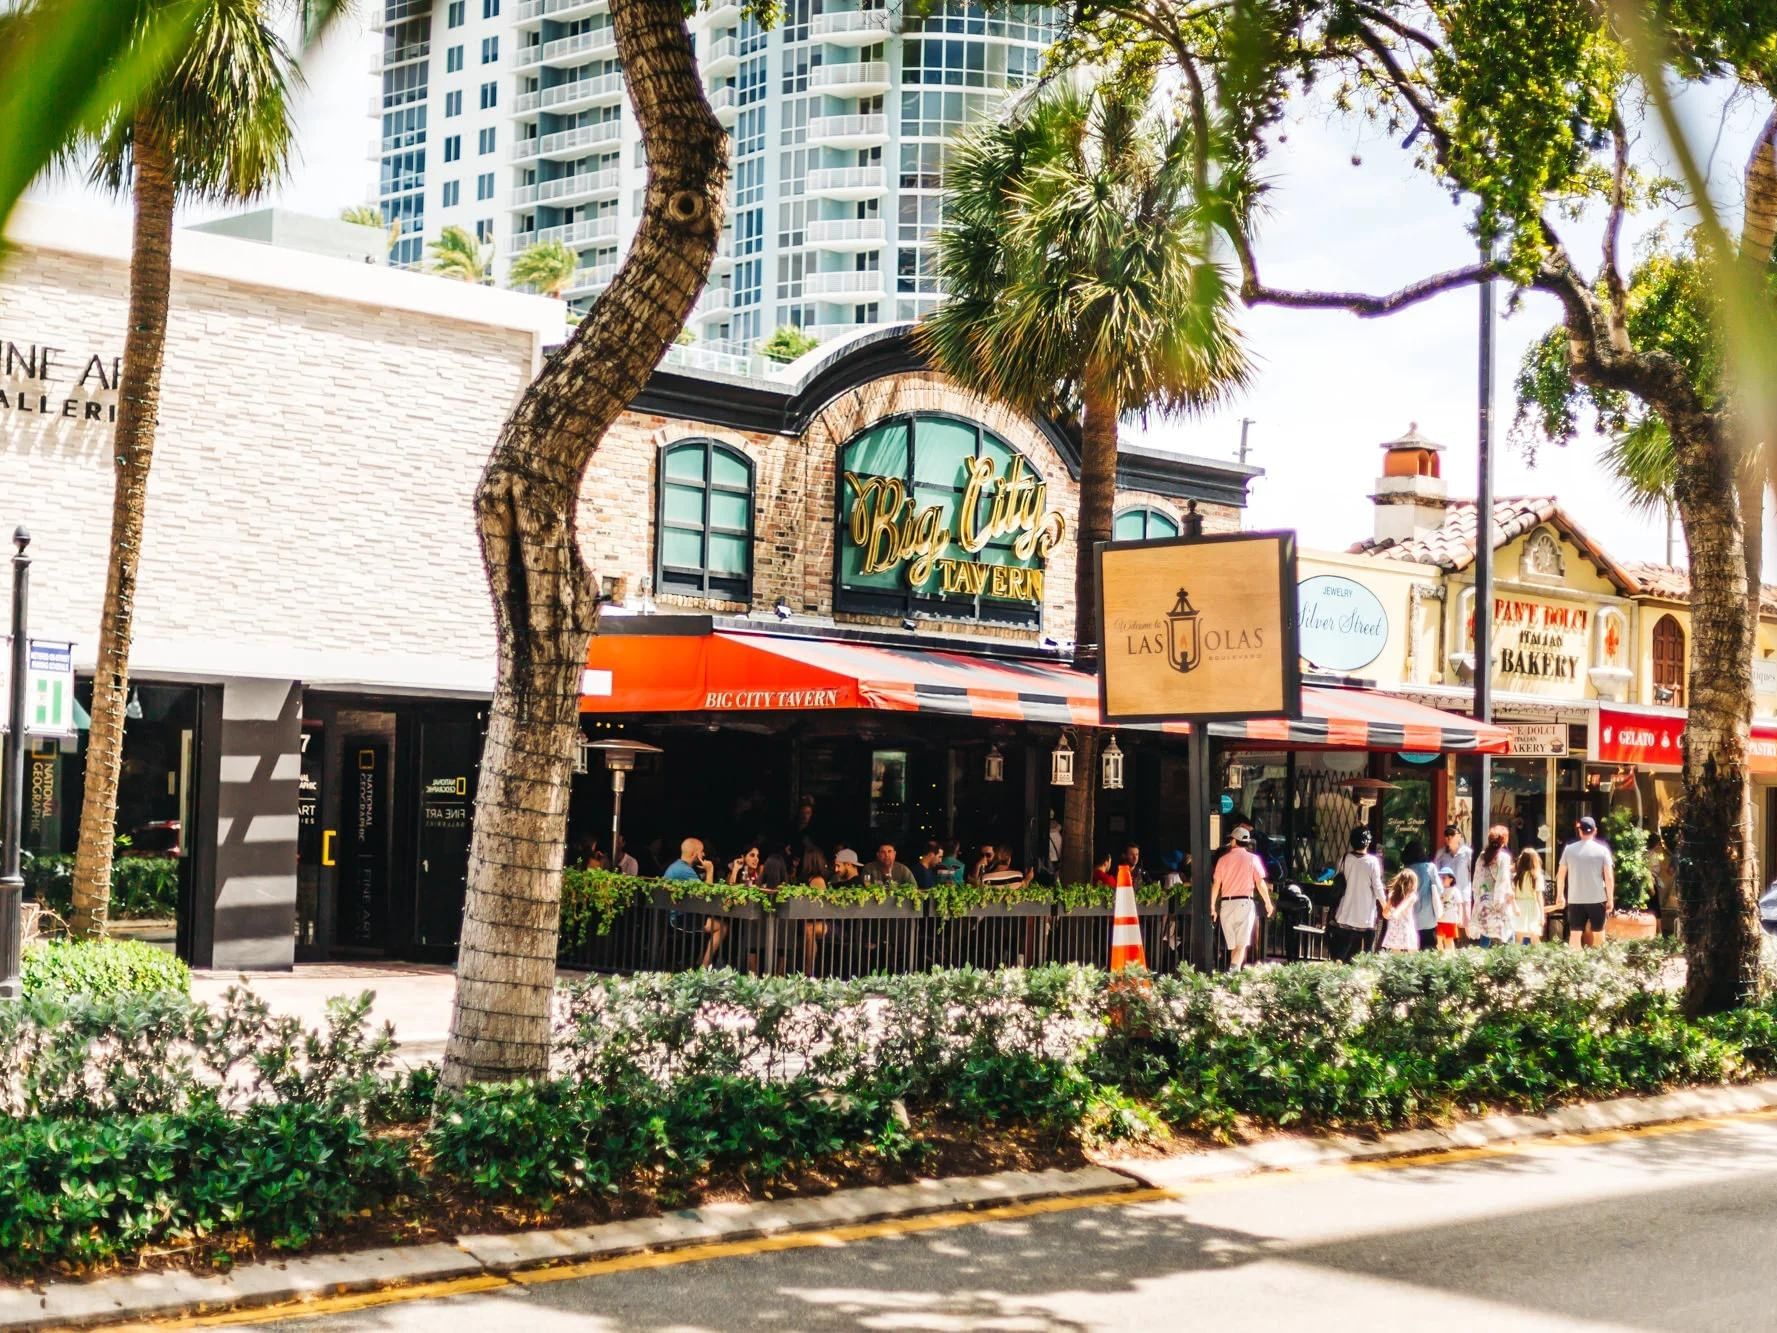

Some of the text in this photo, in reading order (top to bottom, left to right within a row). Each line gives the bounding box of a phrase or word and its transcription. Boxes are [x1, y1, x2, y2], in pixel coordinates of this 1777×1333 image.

[844, 453, 1066, 587] Big City
[938, 559, 1044, 601] TAVERN
[1322, 586, 1353, 598] JEWELRY
[1339, 607, 1382, 636] Street
[1544, 605, 1587, 630] DOLCI
[1127, 628, 1263, 655] LAS OLAS
[1519, 630, 1563, 647] ITALIAN
[1501, 647, 1579, 679] BAKERY
[704, 690, 838, 708] BIG CITY TAVERN
[1512, 743, 1546, 753] AKERY
[1618, 731, 1655, 747] GELATO
[42, 763, 53, 818] NATIONAL
